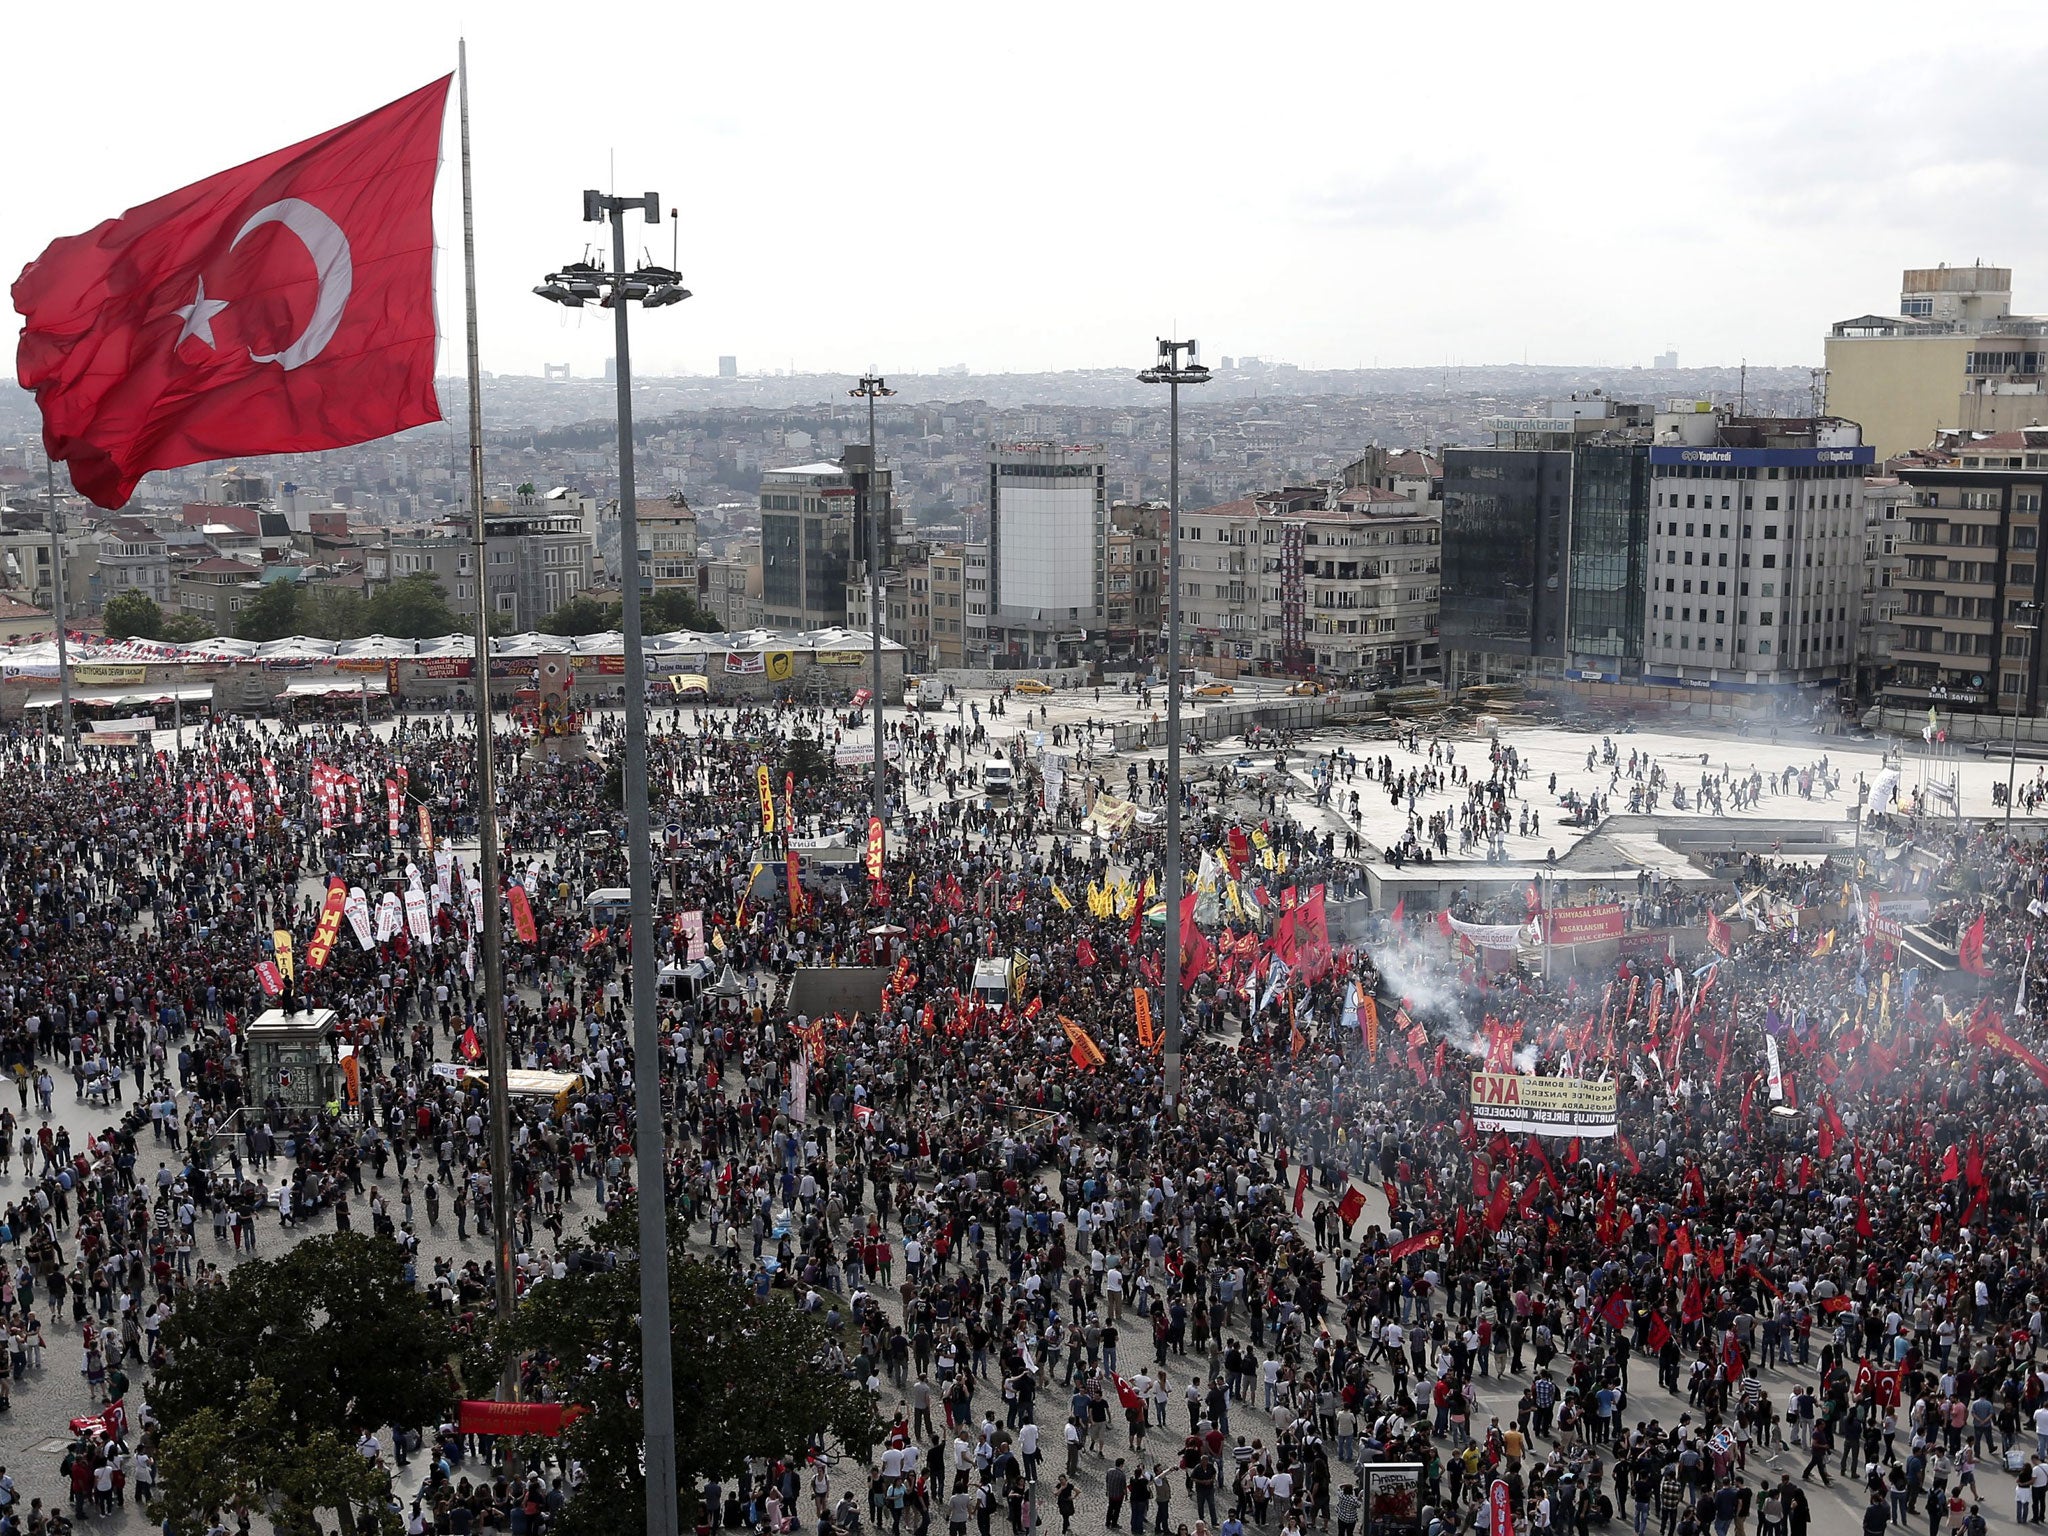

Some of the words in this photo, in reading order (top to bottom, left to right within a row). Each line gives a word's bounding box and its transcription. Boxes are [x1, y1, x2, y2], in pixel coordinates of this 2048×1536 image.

[1496, 419, 1570, 433] bayraktarlar
[760, 774, 771, 826] SYKP
[1559, 910, 1591, 919] KİMYASAL
[1560, 922, 1604, 933] YASAKLANSIN
[1490, 934, 1513, 944] göster
